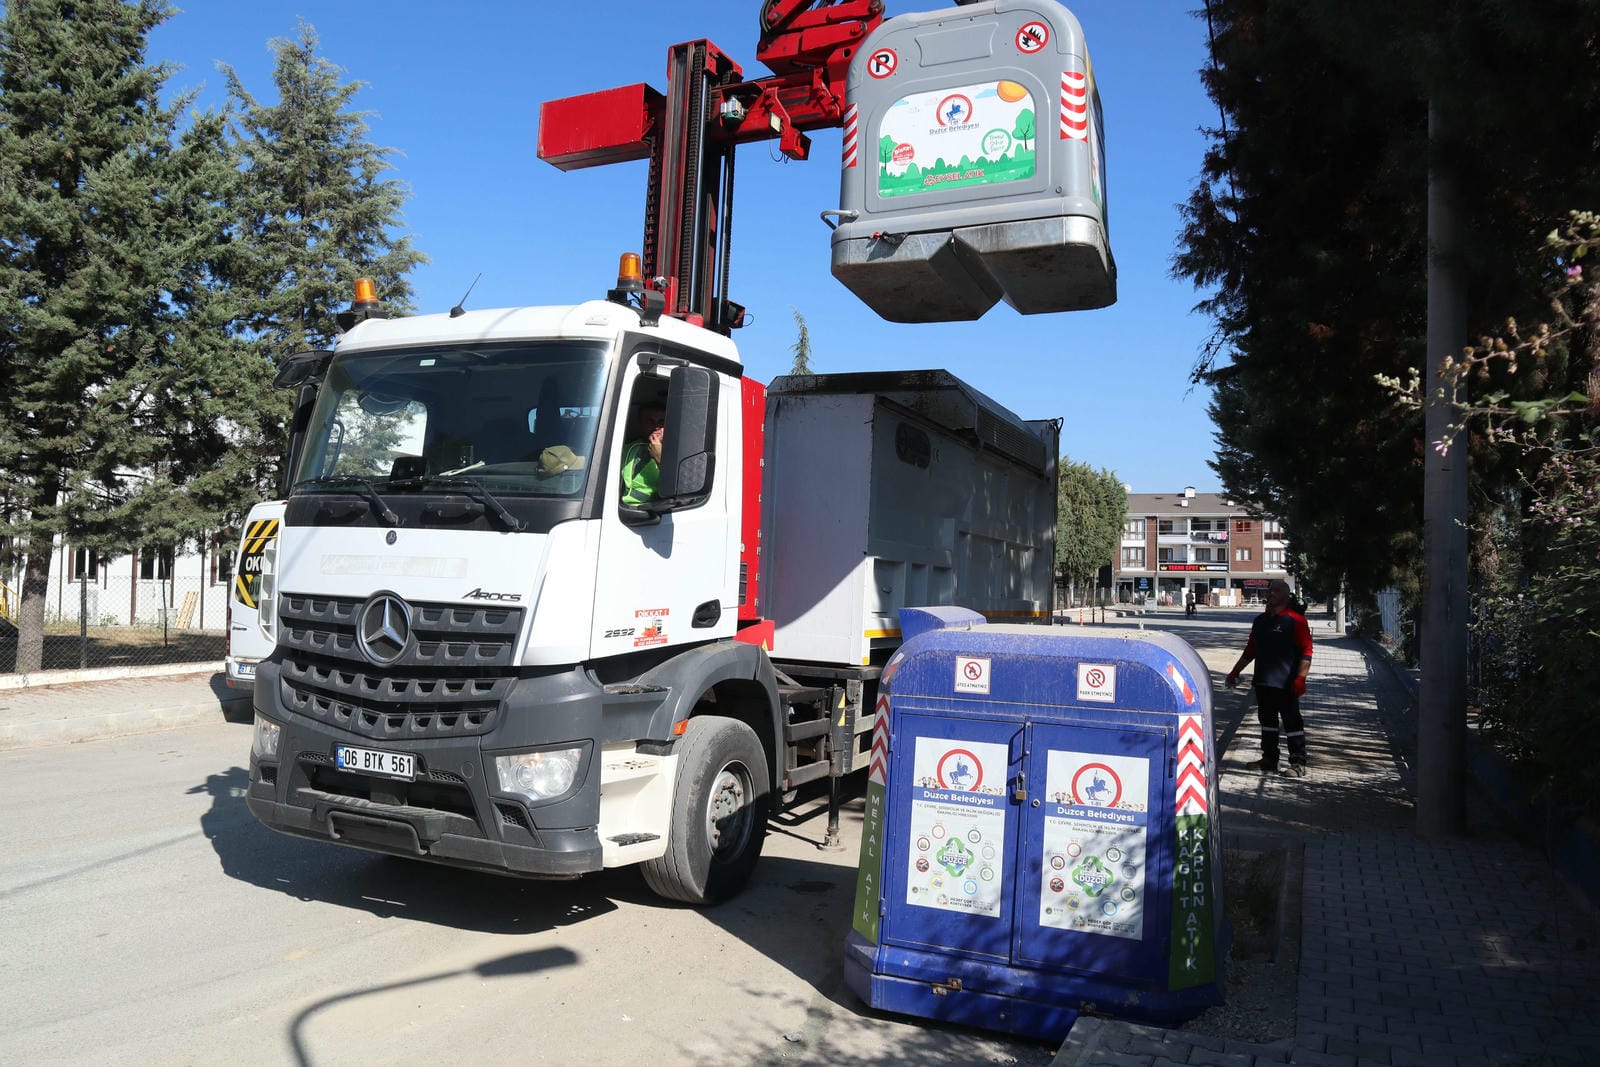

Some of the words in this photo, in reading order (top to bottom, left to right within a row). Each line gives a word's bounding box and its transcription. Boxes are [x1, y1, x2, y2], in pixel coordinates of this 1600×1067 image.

[344, 750, 358, 766] 06
[364, 752, 384, 770] BTK
[392, 756, 411, 774] 561
[924, 790, 950, 800] Düzce
[951, 794, 994, 806] Belediyesi
[1087, 810, 1134, 822] Belediyesi
[869, 794, 880, 857] METAL
[1192, 828, 1204, 907] KARTON
[862, 873, 872, 922] ATIK
[1186, 912, 1198, 970] ATIK
